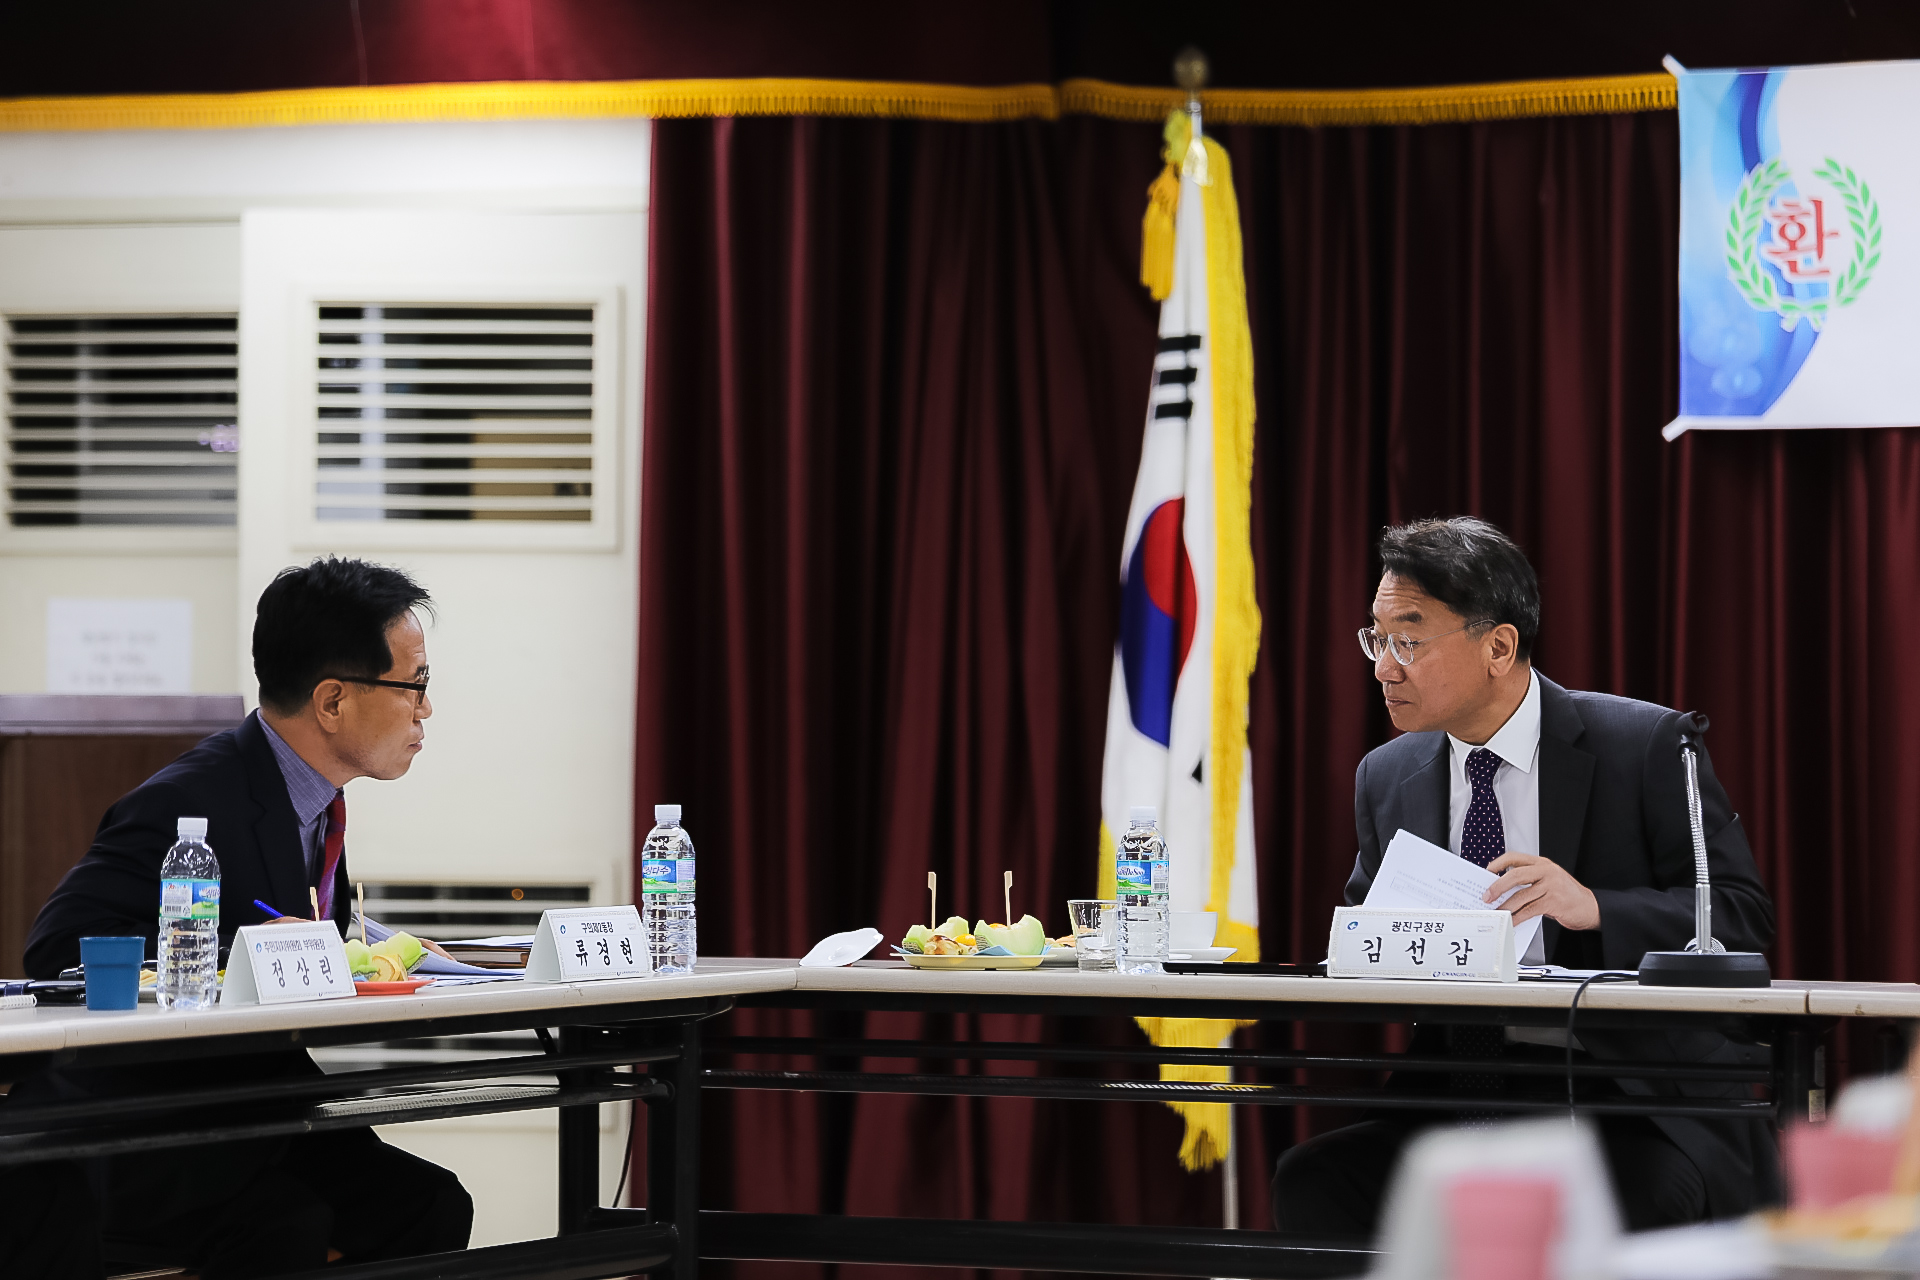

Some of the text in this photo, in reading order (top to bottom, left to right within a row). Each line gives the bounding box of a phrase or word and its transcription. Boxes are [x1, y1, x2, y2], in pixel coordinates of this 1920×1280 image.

[1767, 198, 1841, 277] 환
[1391, 921, 1445, 934] 광진구청장
[303, 938, 326, 951] 부위원장
